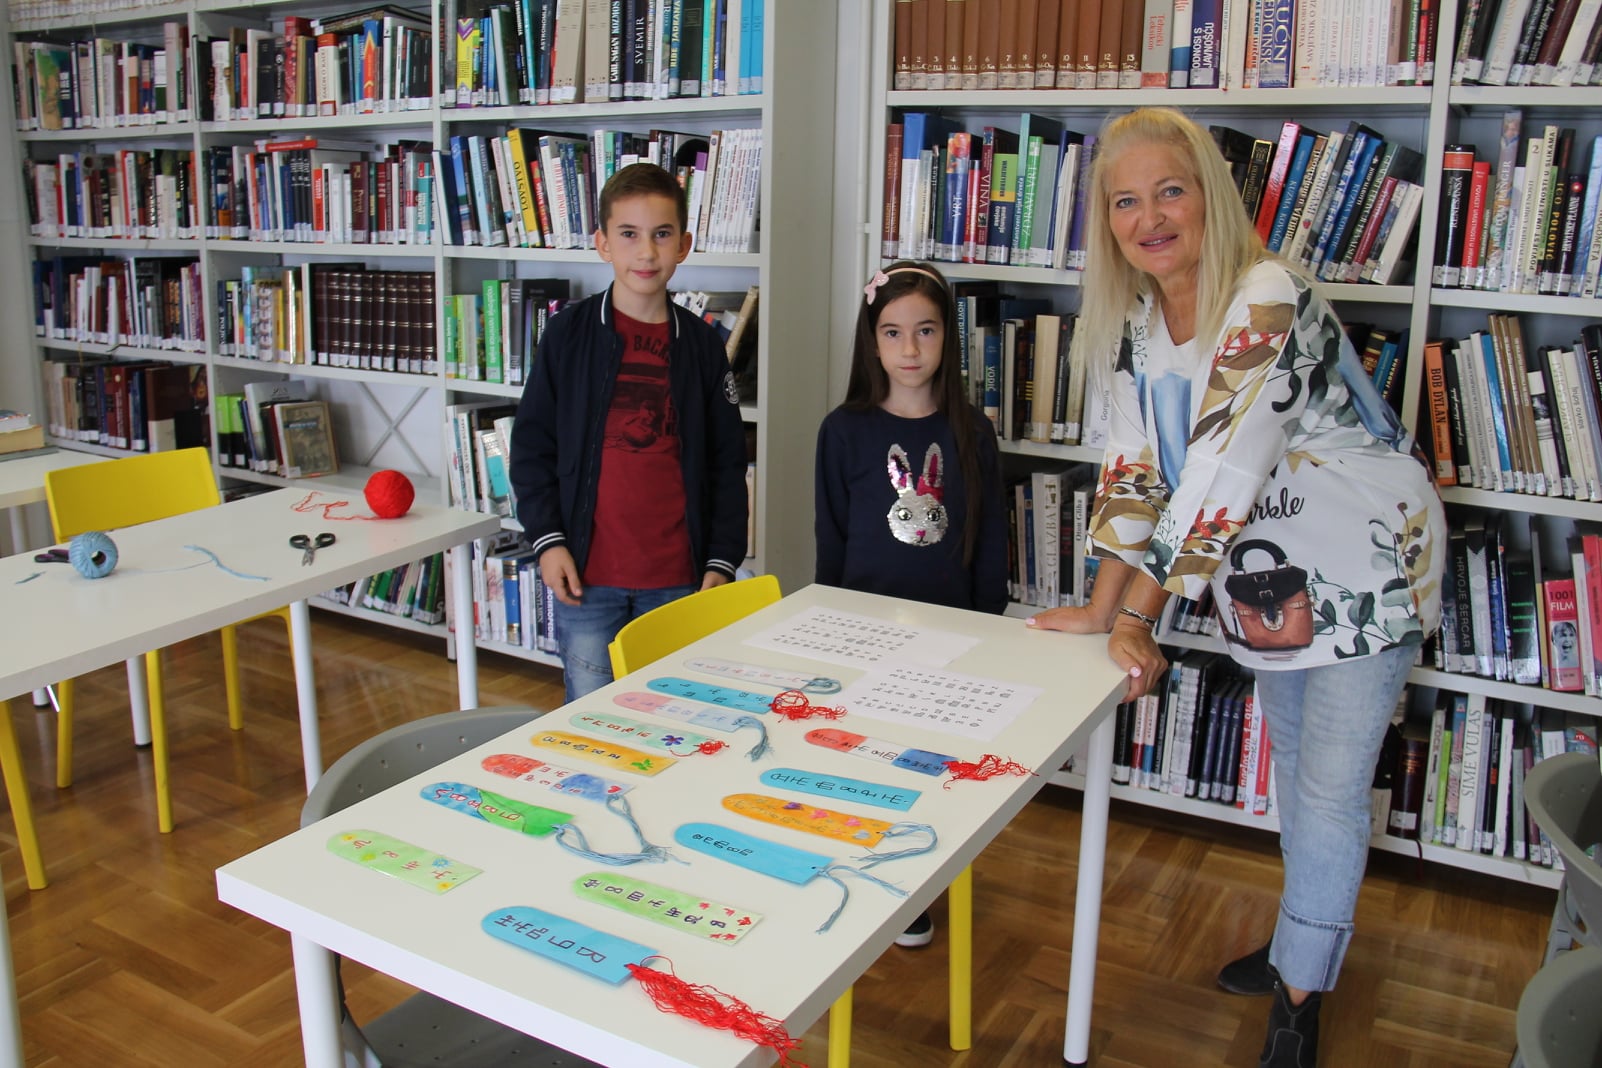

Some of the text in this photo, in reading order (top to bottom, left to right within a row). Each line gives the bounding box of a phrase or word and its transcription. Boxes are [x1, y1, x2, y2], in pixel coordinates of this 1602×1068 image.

[610, 1, 620, 34] KOZMOS
[669, 1, 681, 67] RIBE JADRANA
[610, 37, 619, 62] SAGAN
[634, 16, 645, 65] SVEMIR
[1192, 36, 1202, 68] ODNOSI
[1531, 144, 1540, 154] 2
[513, 161, 529, 212] LOVSTVO
[979, 174, 990, 208] VINA
[1285, 206, 1302, 240] BIBLIJA
[1300, 149, 1321, 197] umjetnosti
[1307, 170, 1328, 215] ORIGAMI
[1450, 176, 1463, 229] RENESANSA
[1529, 232, 1540, 271] POVIJEST
[1535, 179, 1549, 230] UMJETNOSTI
[1544, 131, 1557, 167] SLIKAMA
[951, 195, 963, 218] VRT
[1430, 368, 1442, 387] BOB
[1432, 390, 1447, 424] DYLAN
[1573, 407, 1585, 429] slavko
[1045, 513, 1057, 567] GLAZBA
[1455, 556, 1467, 600] HRVOJE
[1550, 601, 1574, 611] FILM
[1463, 709, 1482, 759] VULAS
